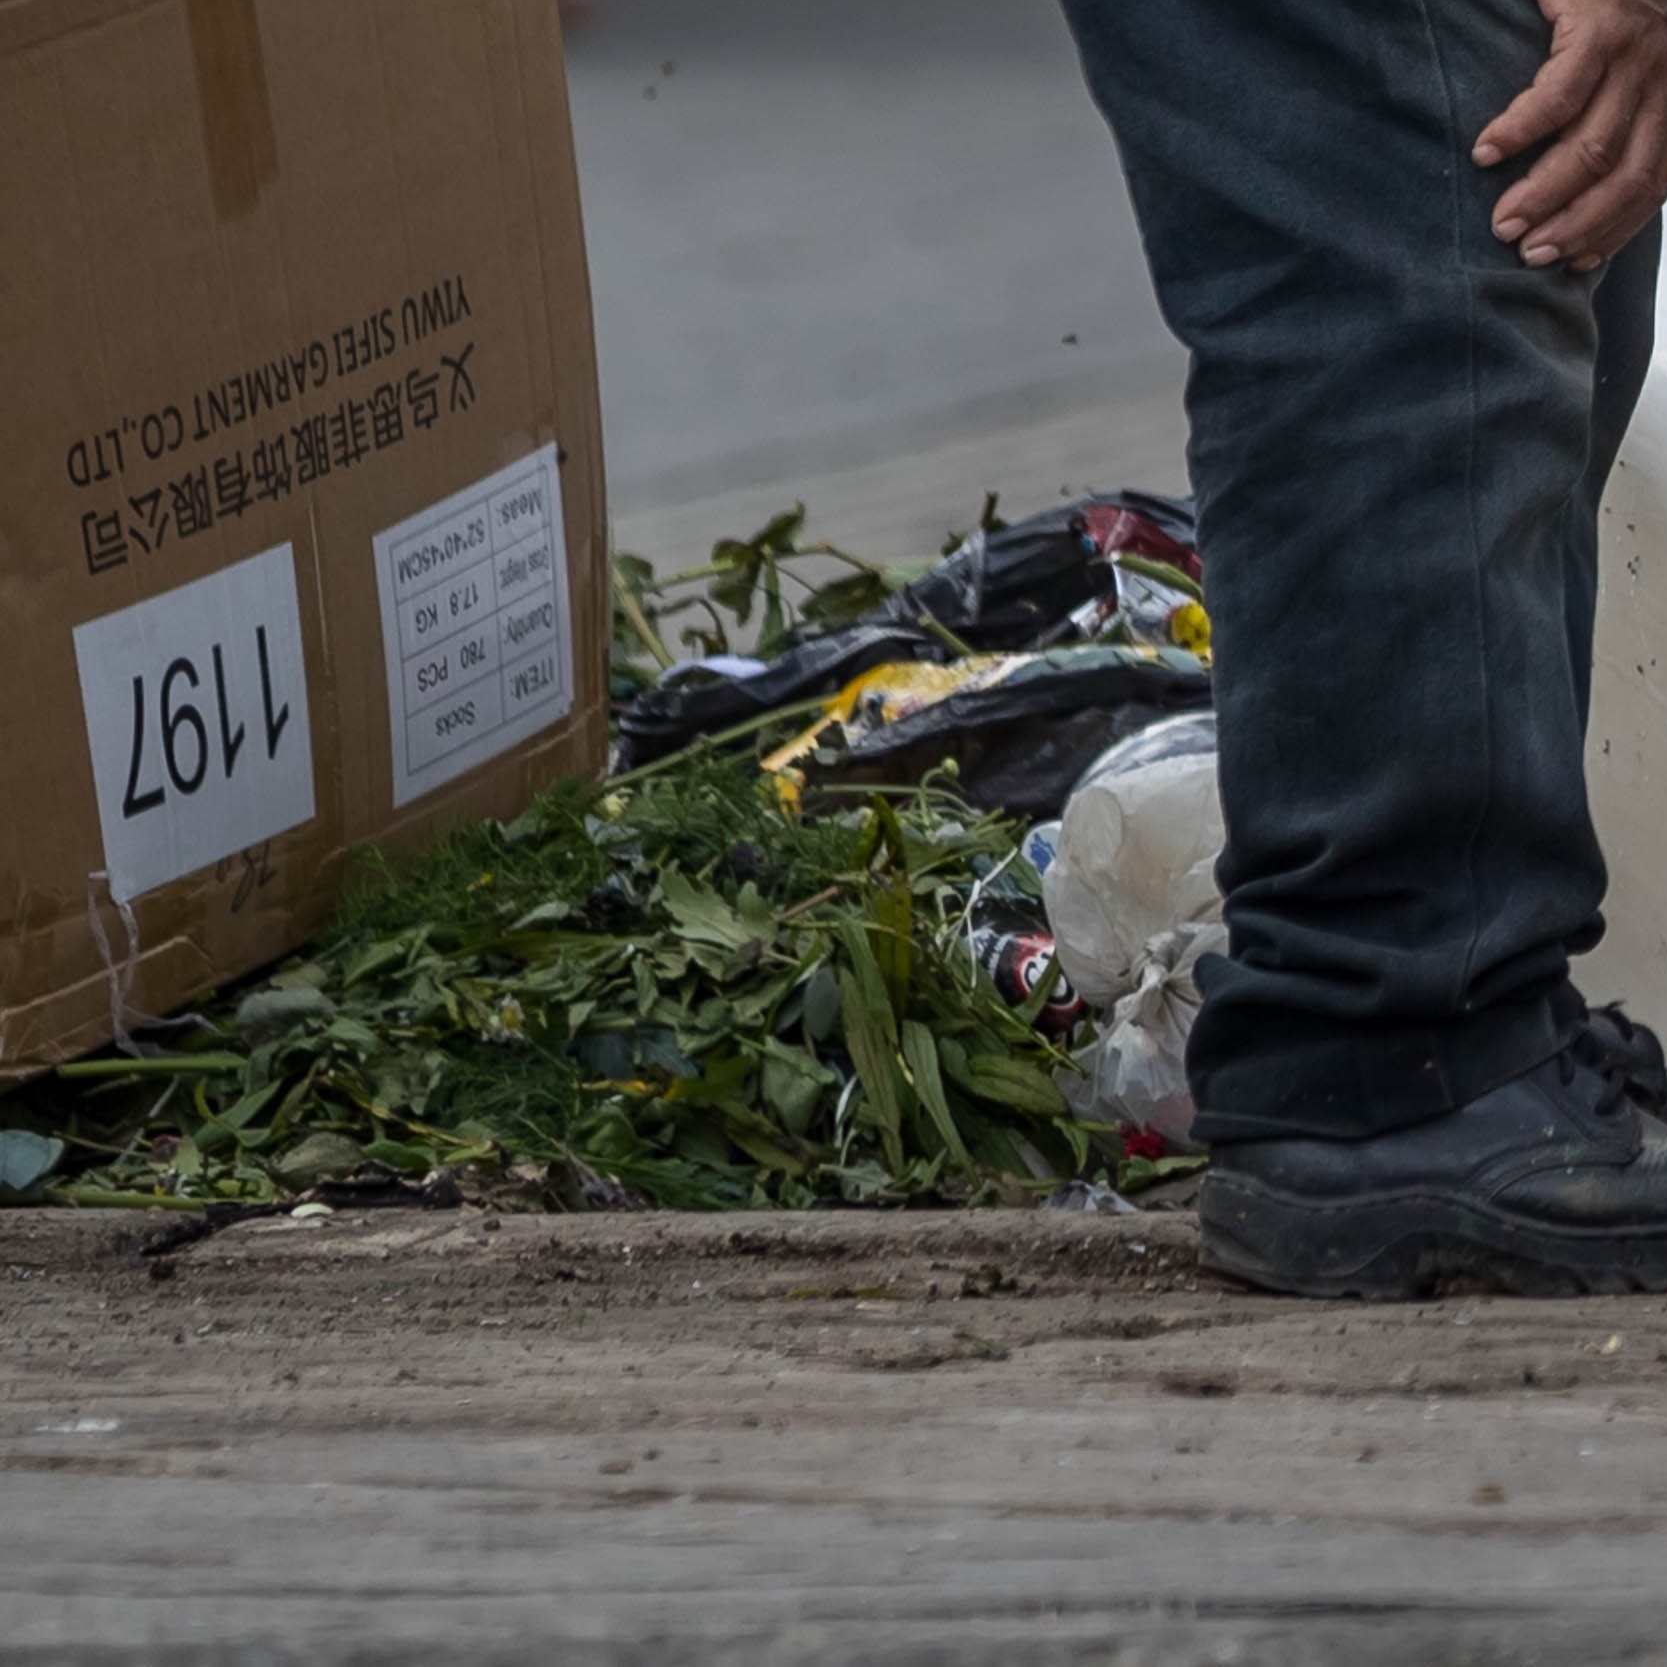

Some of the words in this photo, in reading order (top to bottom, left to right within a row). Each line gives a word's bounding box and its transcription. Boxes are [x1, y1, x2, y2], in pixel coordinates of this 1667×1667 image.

[401, 274, 471, 357] YIWU
[332, 306, 394, 376] SIFEI
[192, 340, 328, 441] GARMENT
[79, 342, 477, 577] 义乌思菲服饰有限公司
[497, 489, 542, 527] Meas:
[415, 603, 439, 634] KG
[449, 582, 480, 616] 17.8
[416, 655, 449, 692] PCS
[459, 637, 487, 670] 780
[508, 657, 555, 700] ITEM:
[121, 624, 290, 820] 1197
[434, 701, 477, 739] Socks
